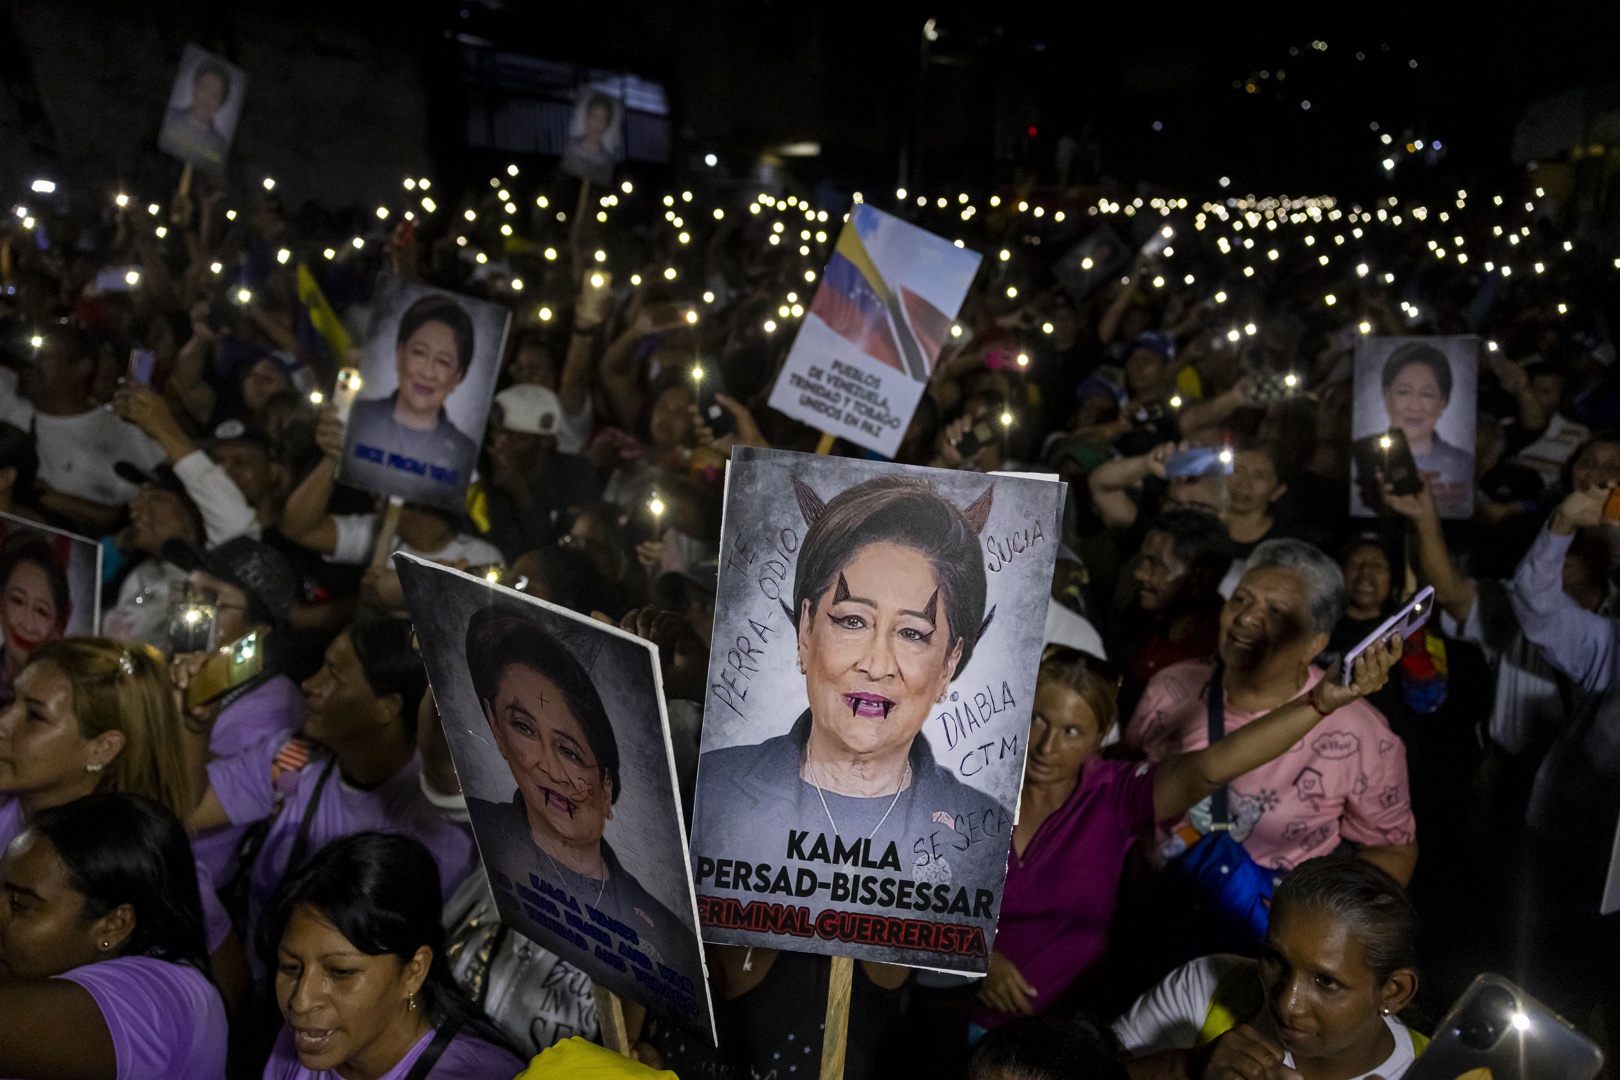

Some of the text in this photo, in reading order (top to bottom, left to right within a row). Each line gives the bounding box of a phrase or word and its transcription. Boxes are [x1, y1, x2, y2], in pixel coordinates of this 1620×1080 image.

[808, 366, 823, 381] DE
[831, 359, 881, 389] PUEBLOS
[789, 373, 900, 429] TRINIDAD Y TOBAGO
[799, 394, 882, 438] UNIDOS EN PAZ
[726, 534, 756, 578] TE
[759, 528, 799, 600] ODIO
[987, 520, 1044, 572] SUCIA
[936, 681, 1016, 751] DIABLA
[960, 734, 1018, 776] CTM
[787, 830, 902, 872] KAMLA
[912, 830, 943, 866] SE
[529, 872, 639, 945] KAMLA WANTS
[695, 856, 994, 919] PERSAD-BISSESSAR
[515, 882, 560, 918] BRING
[564, 910, 612, 949] DEATH
[618, 941, 652, 970] AND
[657, 962, 696, 998] WAR
[816, 910, 987, 957] GUERRERISTA
[523, 902, 588, 950] TRINIDAD
[594, 945, 627, 973] AND
[631, 964, 700, 1018] TOBAGO
